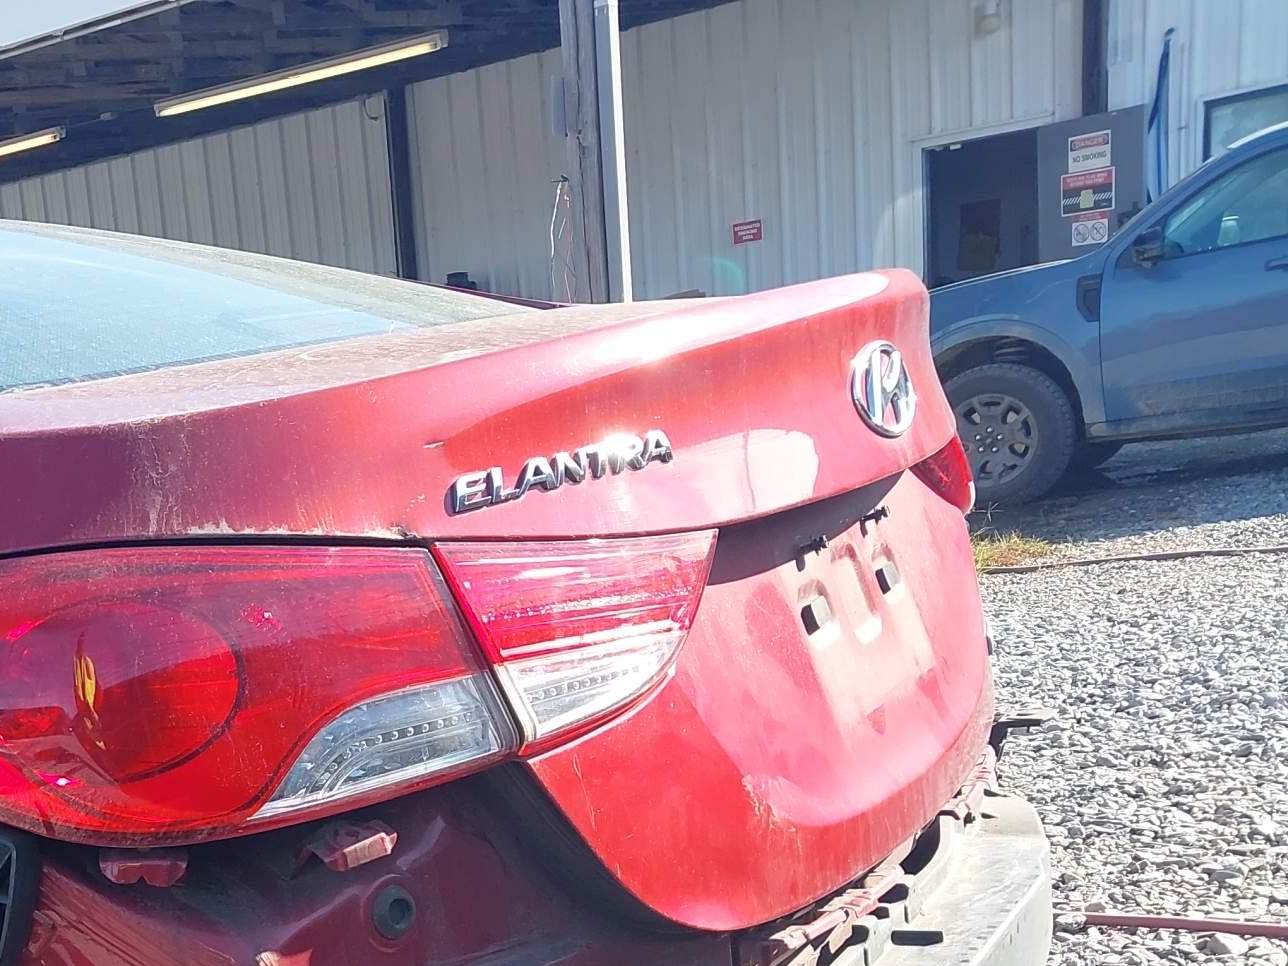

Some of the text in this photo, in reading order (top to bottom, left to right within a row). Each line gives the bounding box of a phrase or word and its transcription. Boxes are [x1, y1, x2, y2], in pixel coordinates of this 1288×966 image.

[1073, 151, 1107, 163] NO SMOKING
[444, 429, 673, 516] ELANTRA
